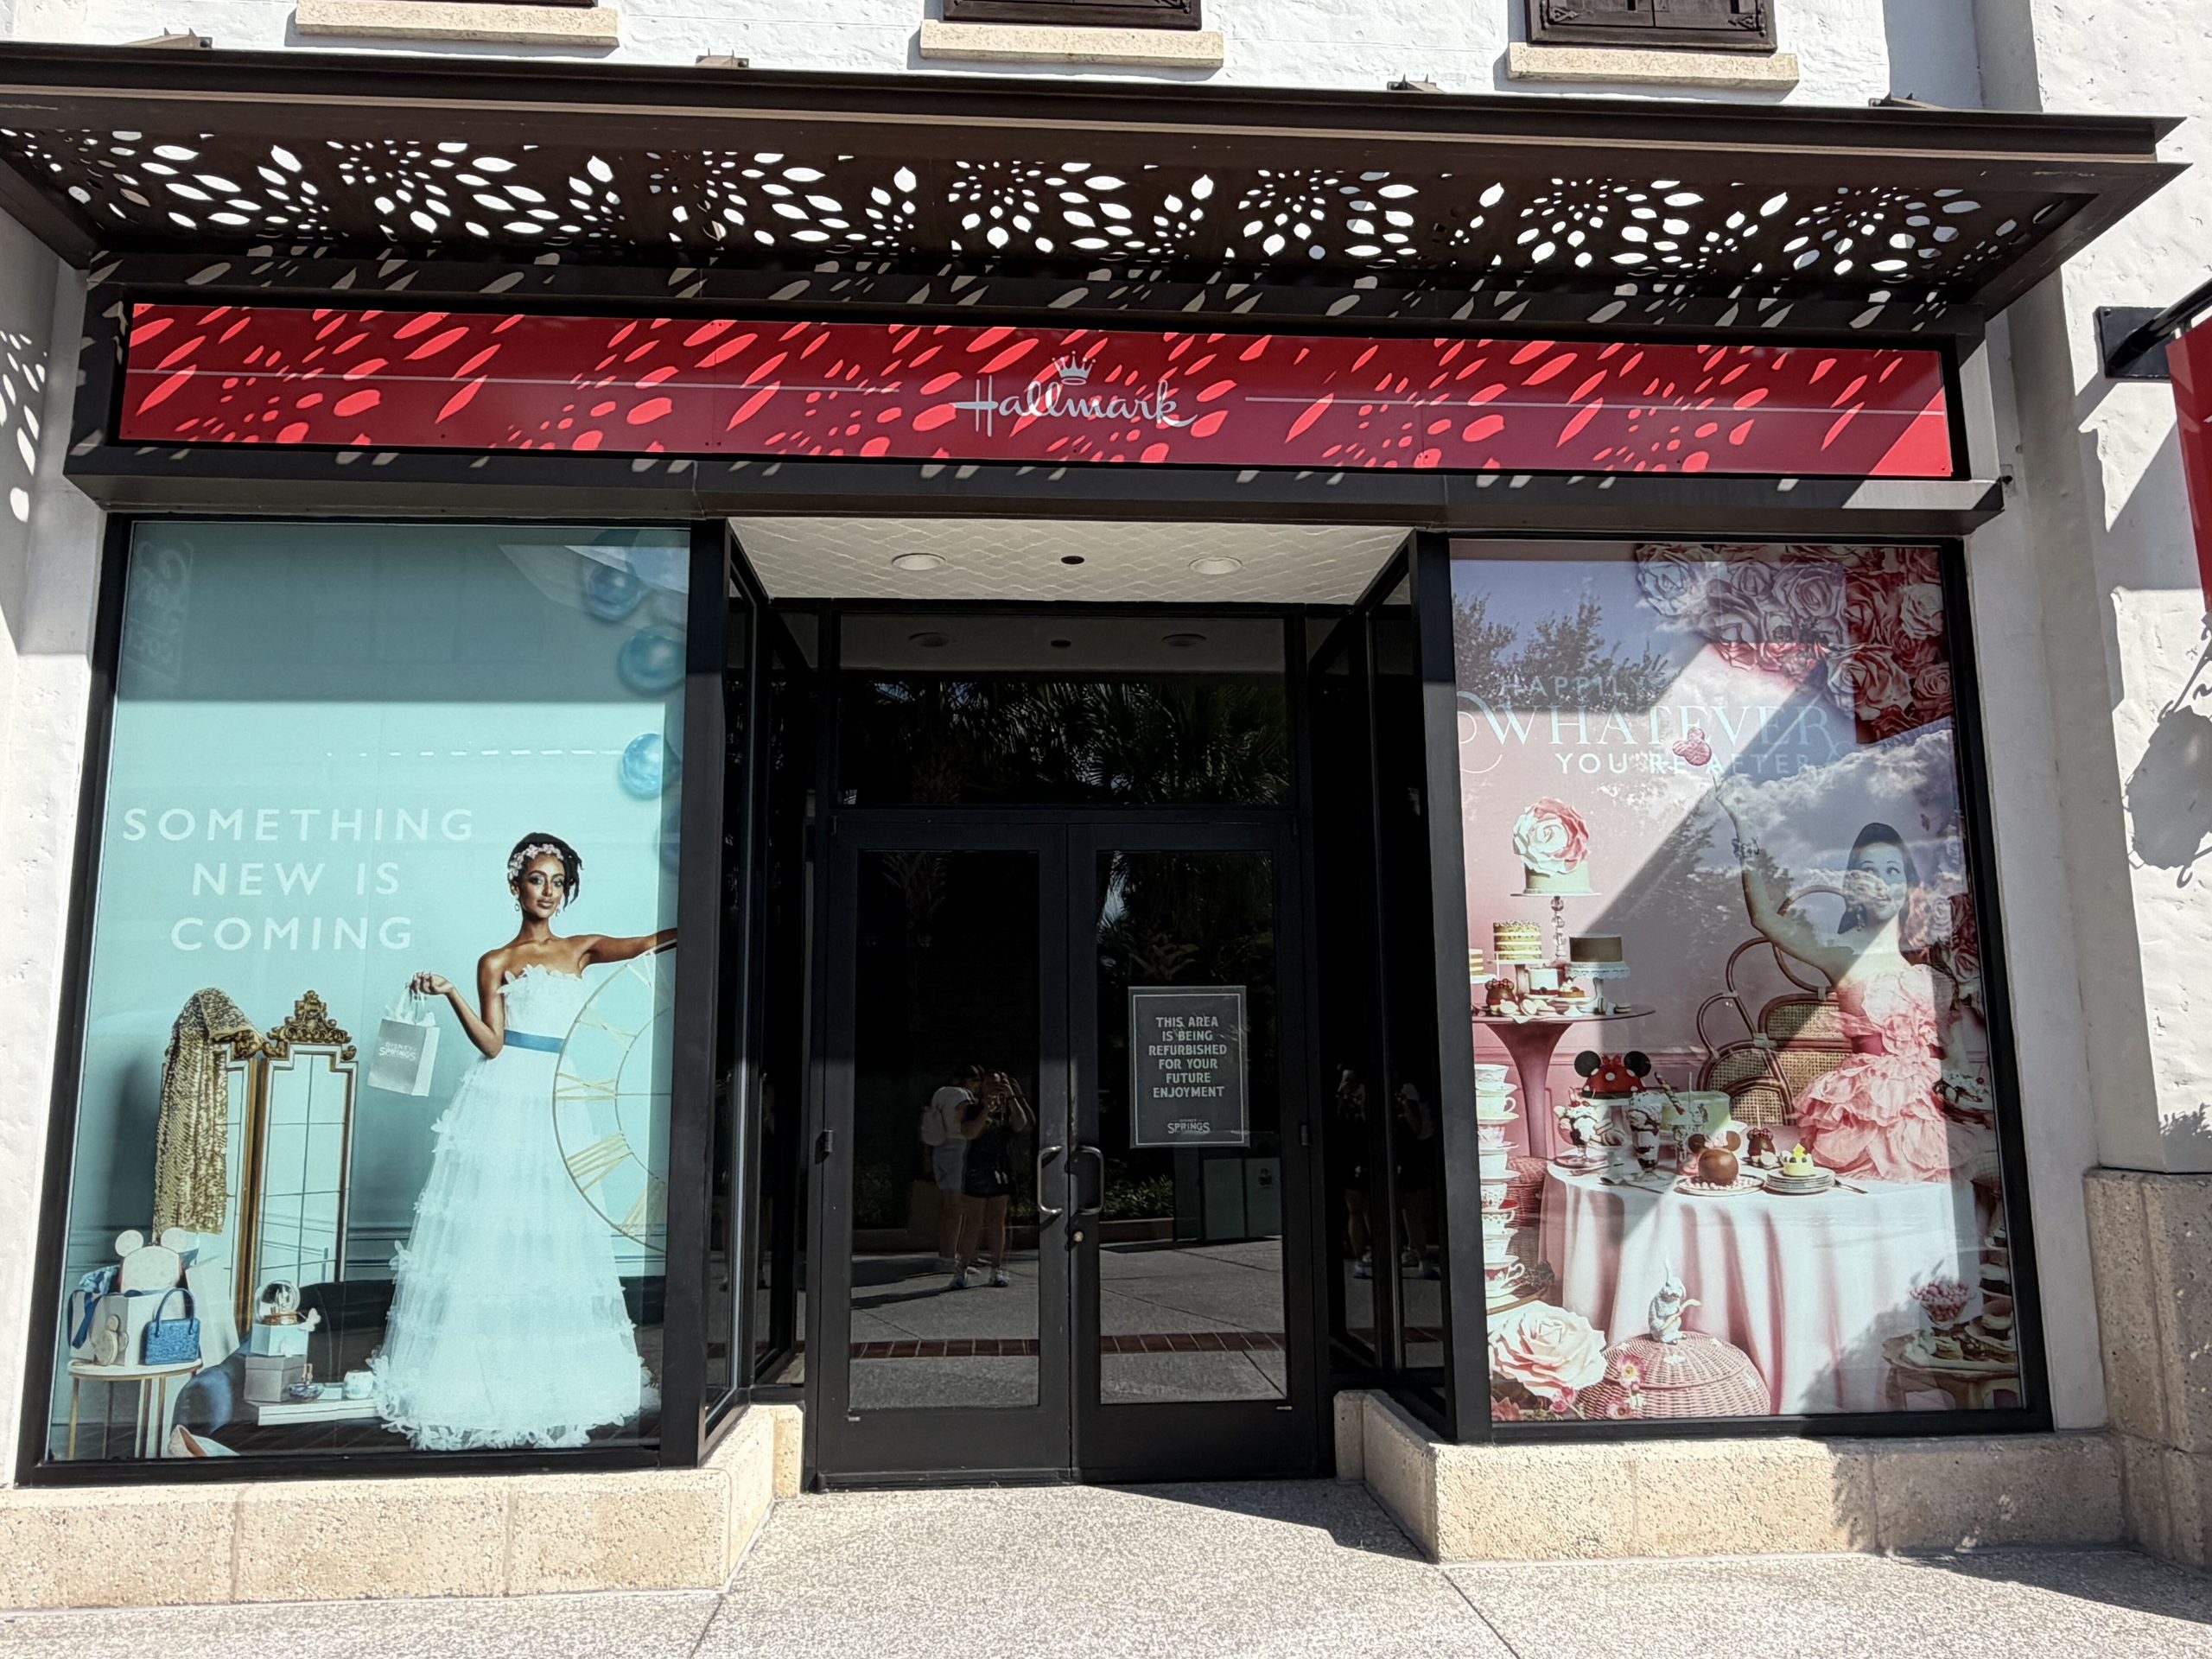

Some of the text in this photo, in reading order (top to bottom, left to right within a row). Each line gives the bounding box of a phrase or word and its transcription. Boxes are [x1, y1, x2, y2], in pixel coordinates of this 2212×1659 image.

[950, 375, 1198, 437] Hallmark
[1459, 692, 1845, 757] WHATEVER
[1706, 753, 1812, 776] AFTER
[123, 808, 473, 842] SOMETHING
[192, 861, 399, 896] NEW IS
[171, 917, 411, 950] COMING
[1155, 1016, 1218, 1028] THIS AREA
[1162, 1030, 1213, 1042] IS BEING
[1148, 1044, 1228, 1056] REFURBISHED
[1159, 1058, 1218, 1070] FOR YOUR
[1166, 1072, 1211, 1084] FUTURE
[1153, 1086, 1224, 1098] ENJOYMENT
[1167, 1122, 1211, 1134] SPRINGS
